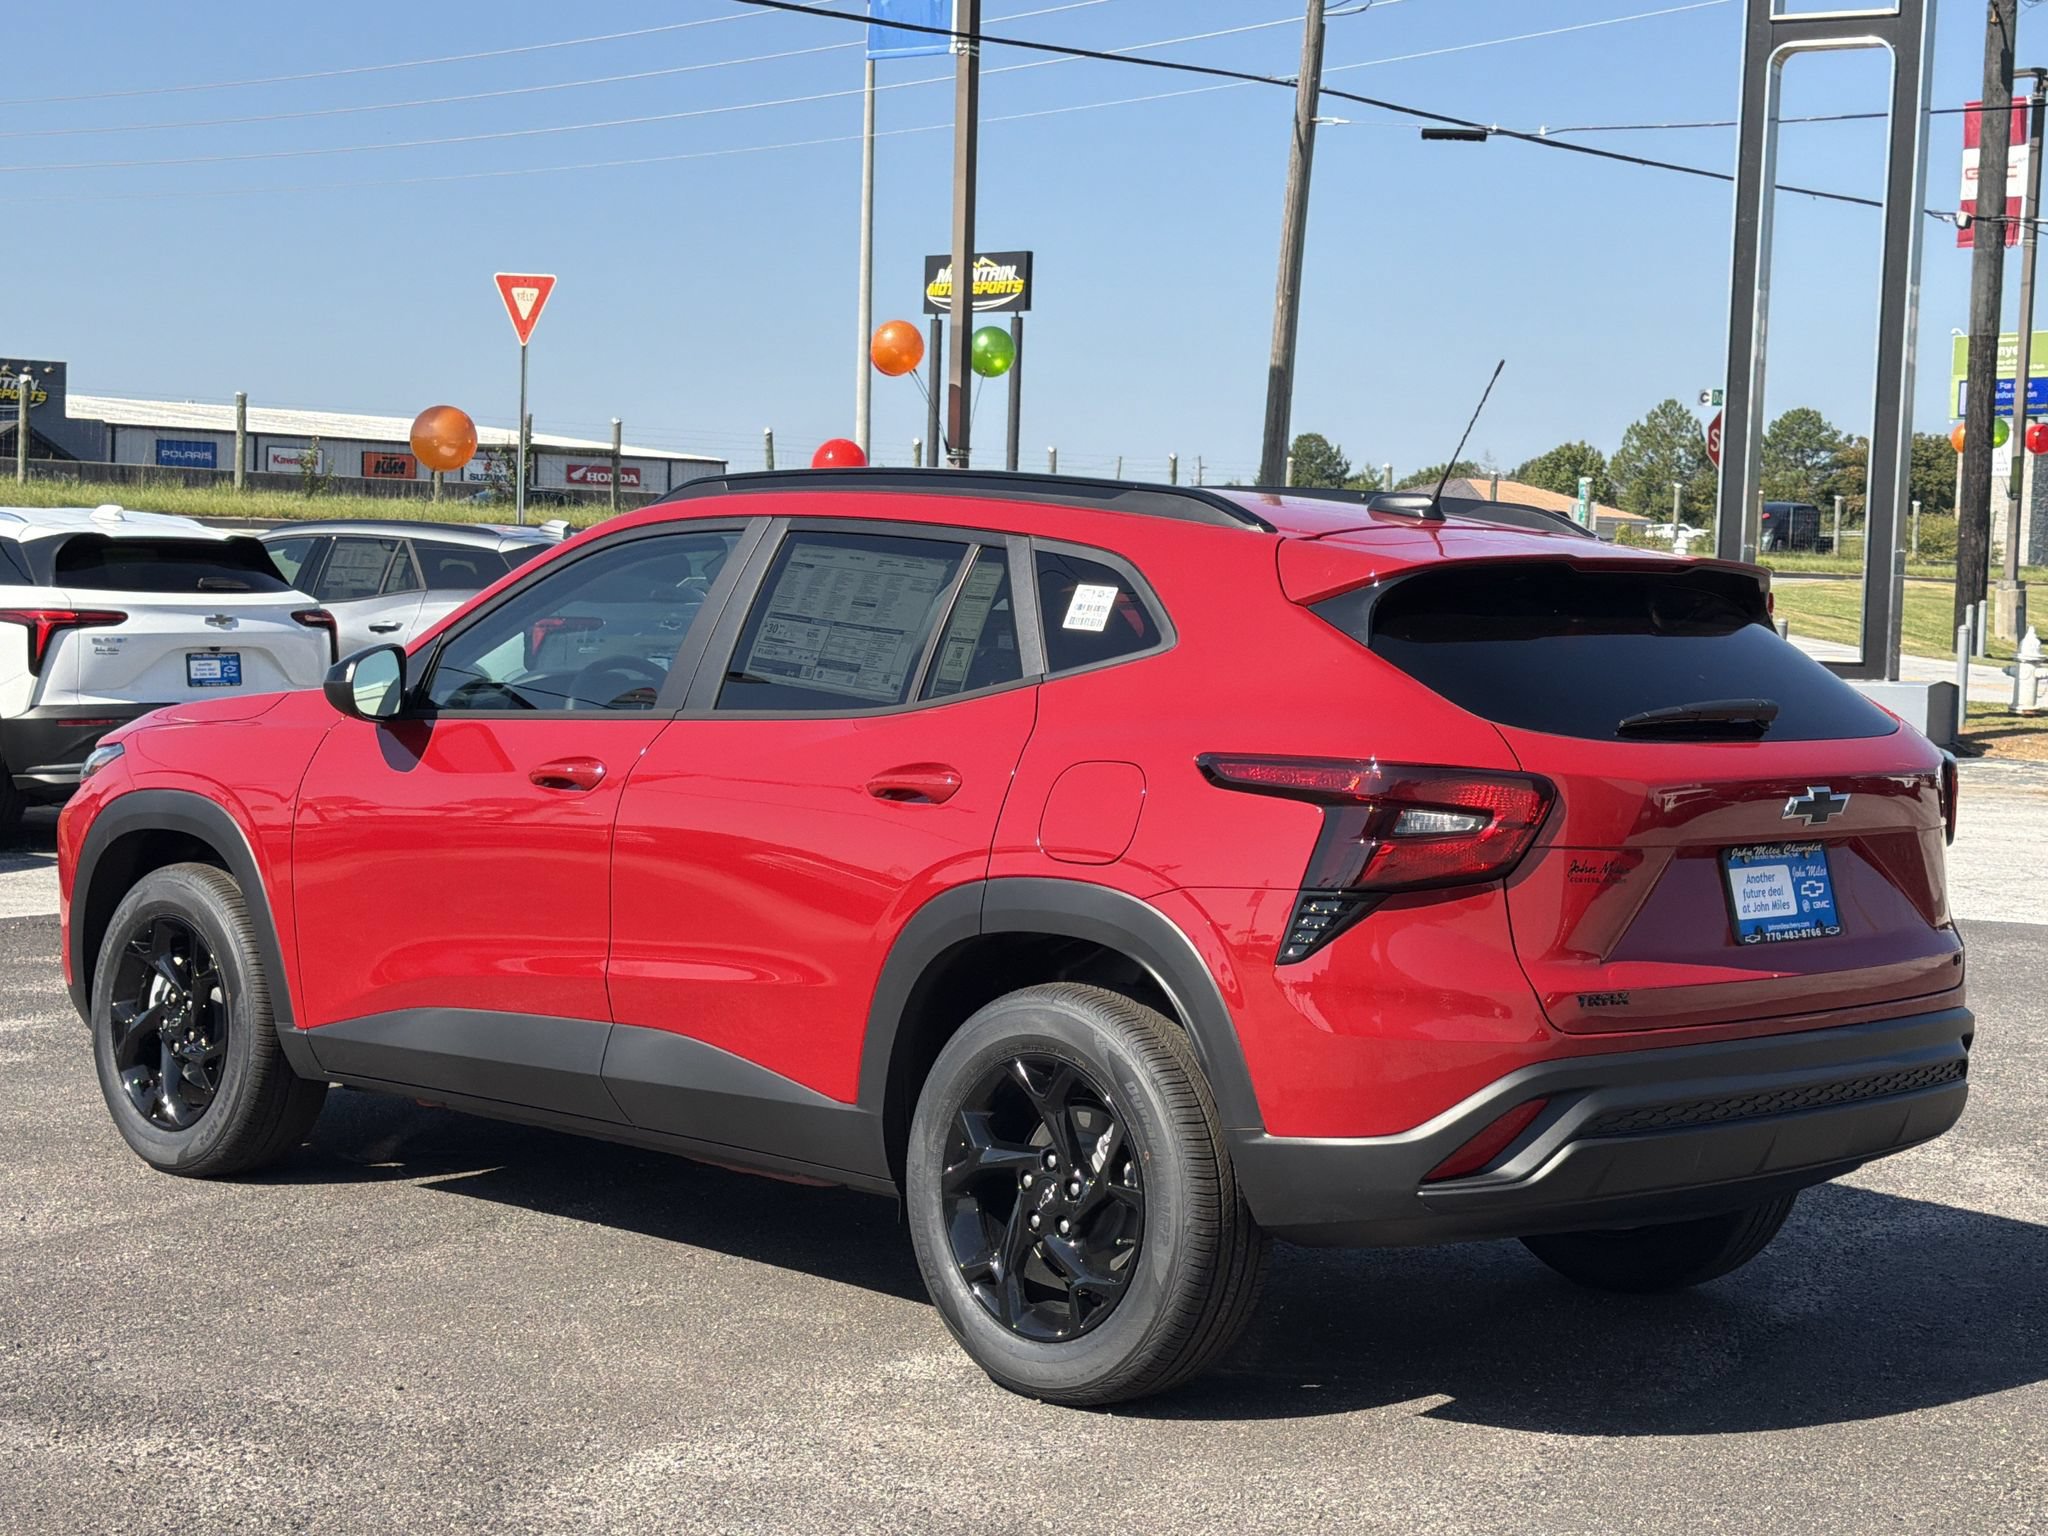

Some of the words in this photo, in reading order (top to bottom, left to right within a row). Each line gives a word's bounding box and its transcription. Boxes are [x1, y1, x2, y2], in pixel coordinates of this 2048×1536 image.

[161, 449, 213, 460] POLARIS
[374, 456, 406, 475] KTM
[1731, 847, 1753, 860] John
[1753, 844, 1782, 857] Miles
[1745, 872, 1776, 885] Another
[1743, 888, 1766, 902] future
[1767, 886, 1785, 898] deal
[1742, 904, 1751, 914] at
[1752, 902, 1770, 913] John
[1771, 899, 1791, 911] Miles
[1812, 900, 1831, 909] GMC
